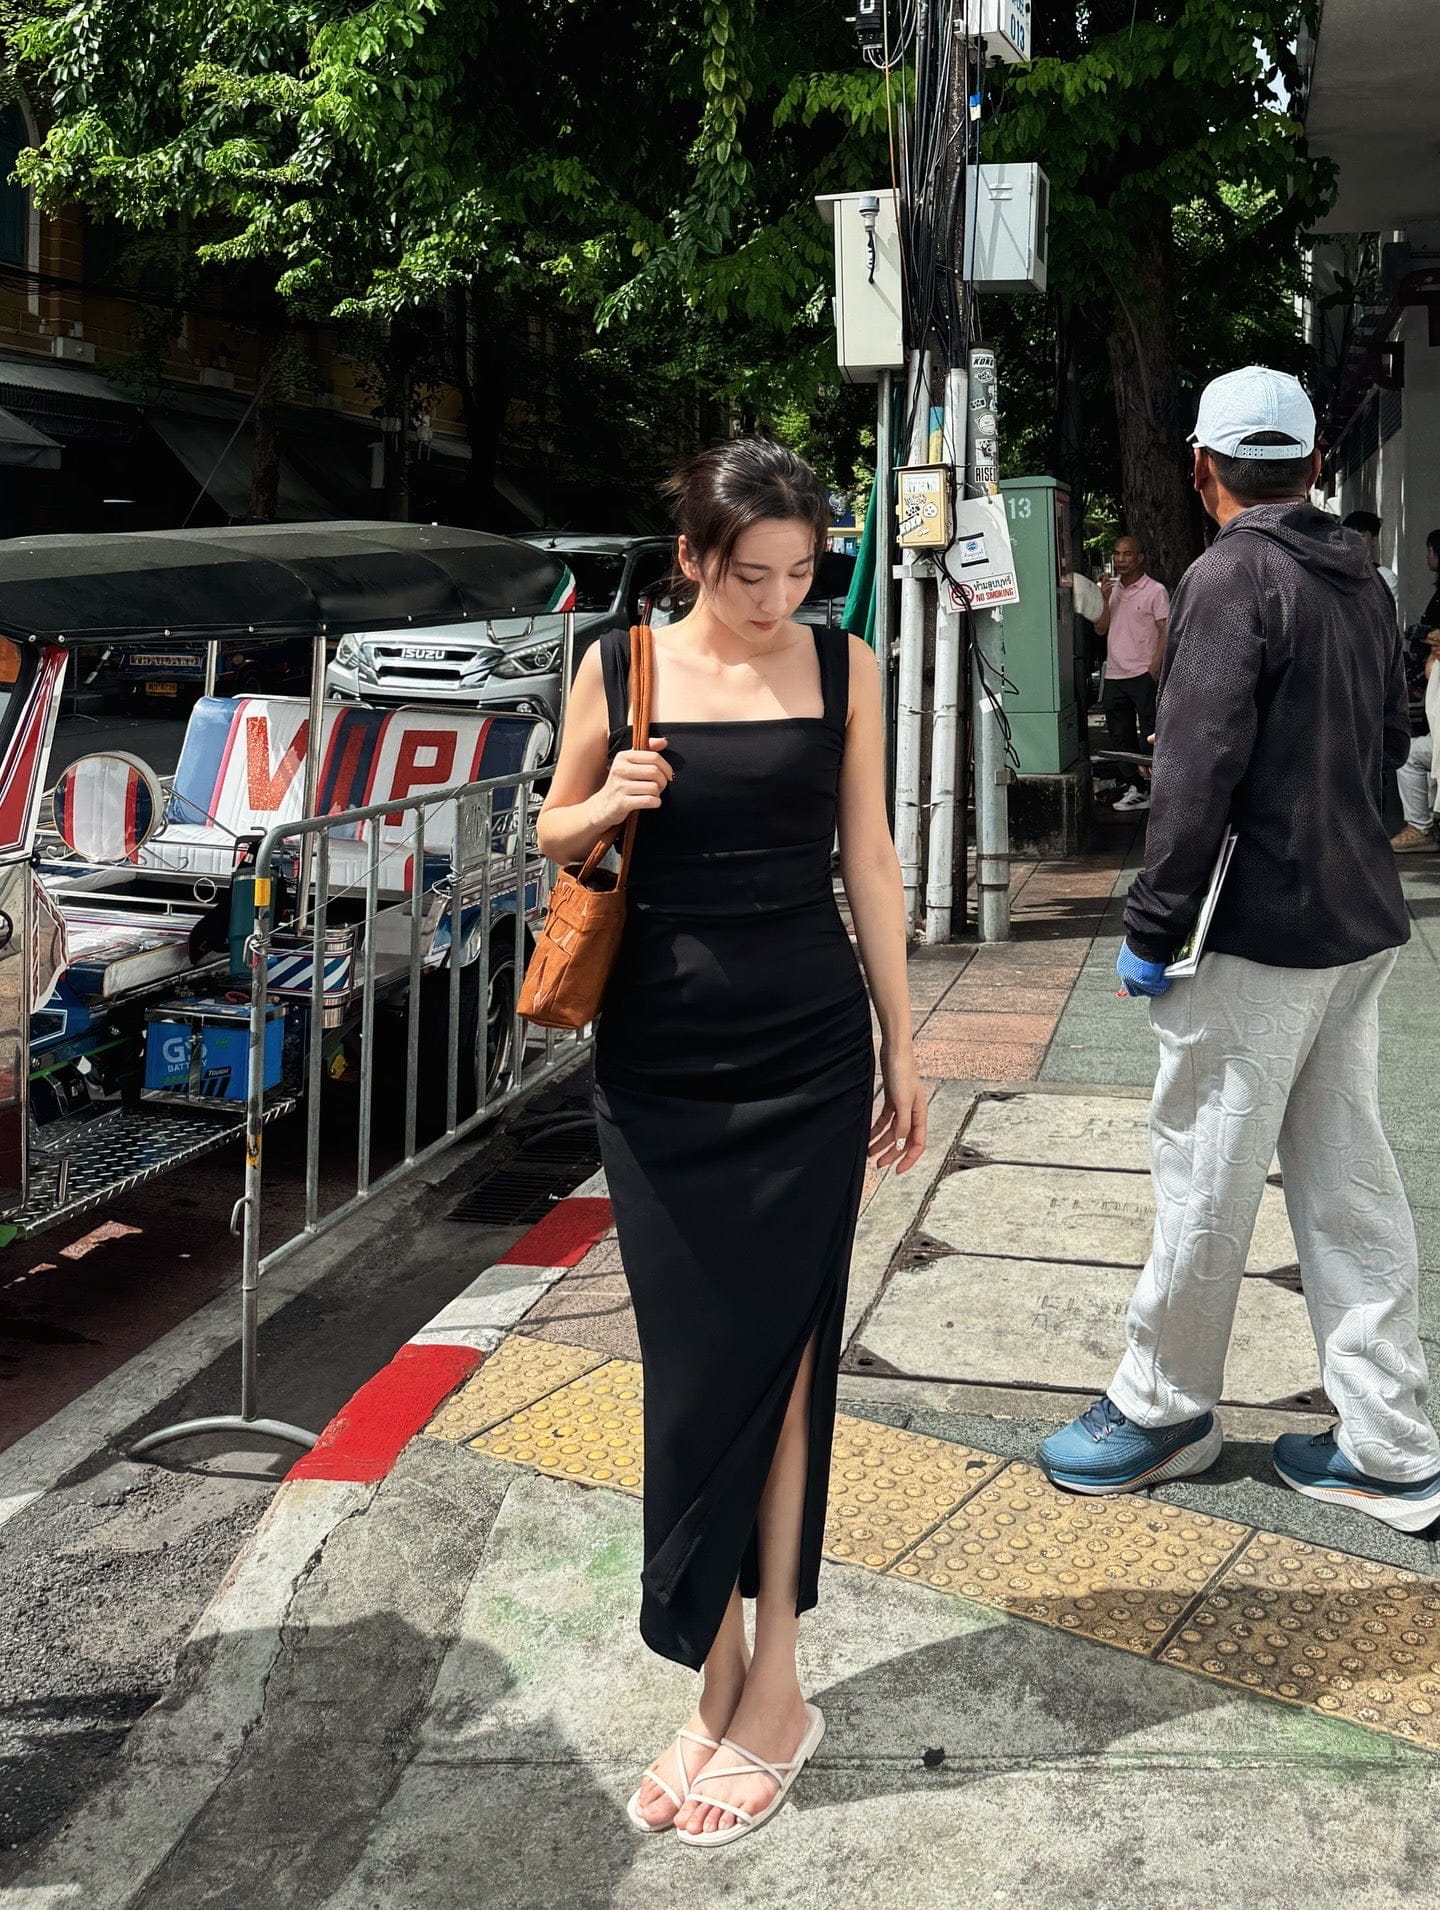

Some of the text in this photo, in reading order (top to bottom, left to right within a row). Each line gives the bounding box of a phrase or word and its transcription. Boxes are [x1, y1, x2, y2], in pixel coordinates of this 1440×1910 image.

[1010, 13, 1025, 52] 013
[1008, 497, 1032, 520] 13
[976, 587, 1014, 602] NO SMOKING
[401, 648, 446, 660] ISUZU
[246, 716, 458, 827] VIP
[167, 1059, 208, 1073] BATTY
